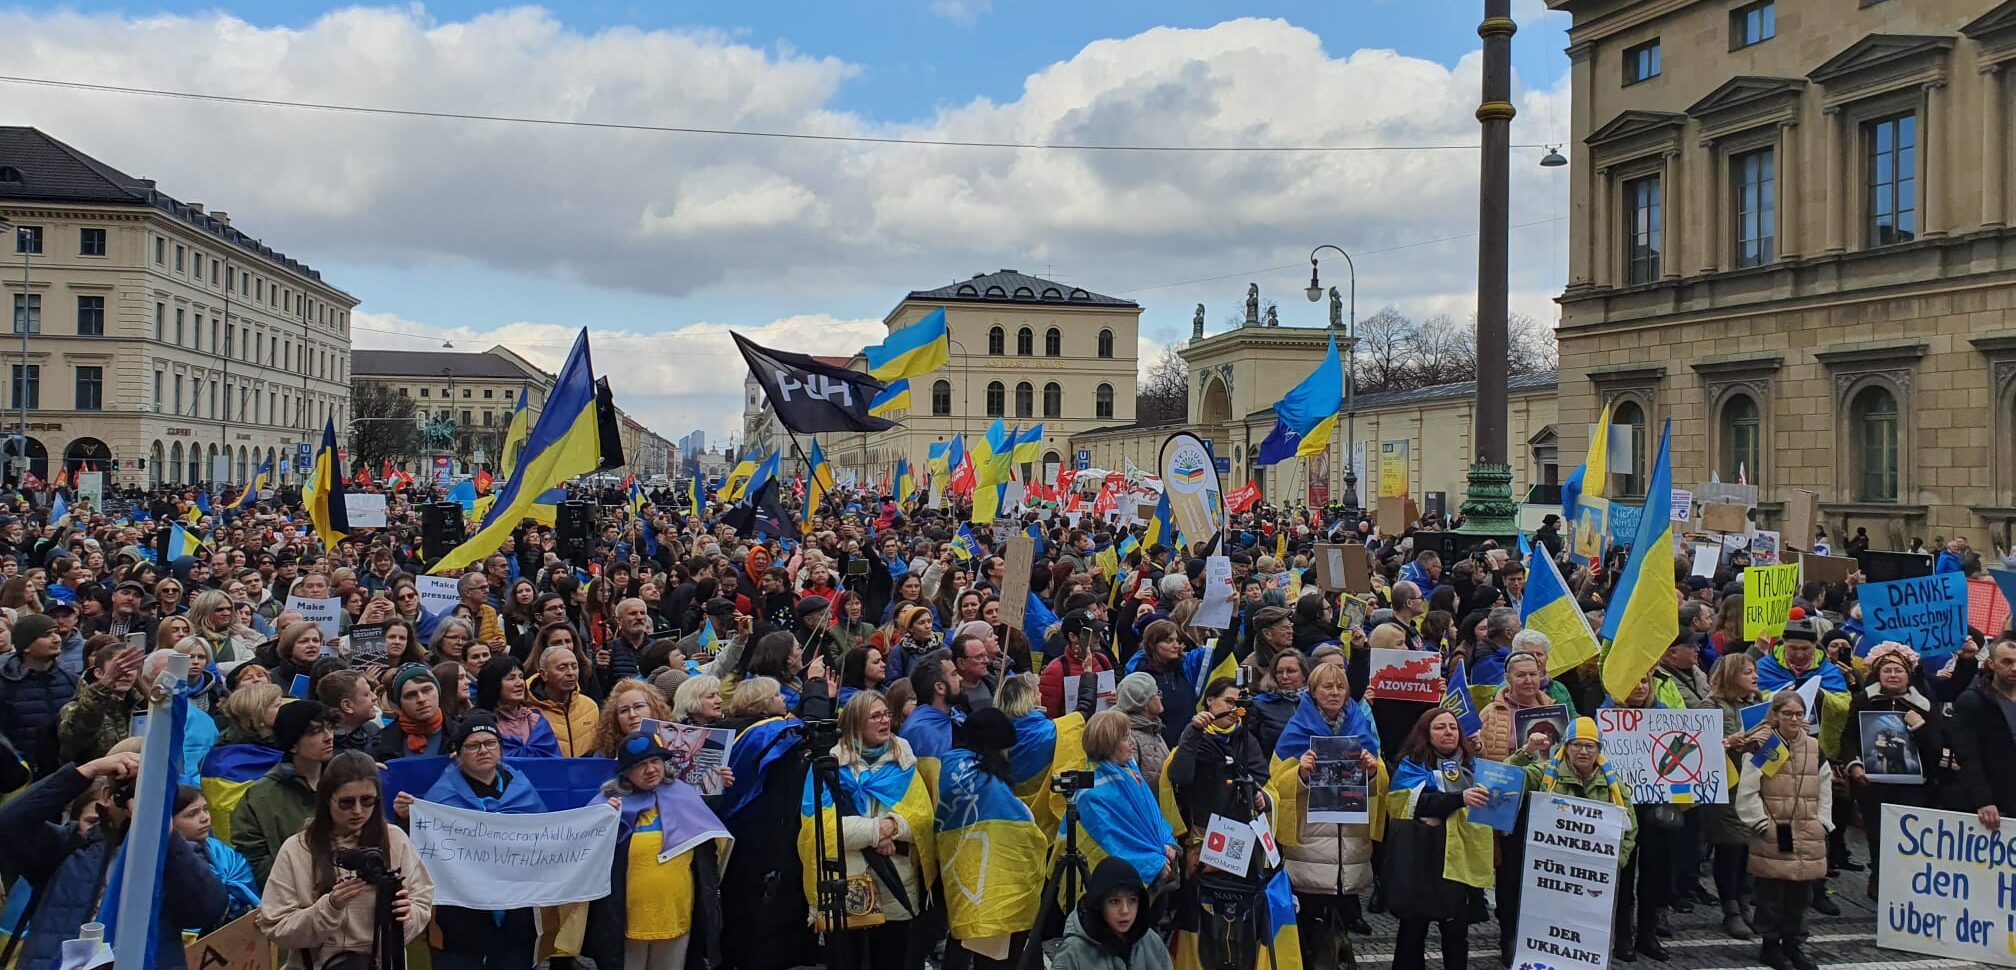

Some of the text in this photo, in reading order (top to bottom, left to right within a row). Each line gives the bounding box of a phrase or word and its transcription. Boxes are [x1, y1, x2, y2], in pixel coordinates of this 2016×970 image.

[1080, 451, 1088, 460] U
[431, 580, 456, 589] Make
[1753, 565, 1797, 598] TAURUS
[1888, 577, 1954, 607] DANKE
[296, 601, 326, 611] Make
[1920, 625, 1955, 652] ZSU
[1377, 680, 1433, 693] AZOVSTAL
[1600, 709, 1644, 733] STOP
[1602, 738, 1652, 756] RUSSIAN
[1699, 770, 1720, 785] US
[1693, 783, 1720, 804] SKY
[1571, 804, 1604, 820] WIR
[1555, 818, 1596, 835] SIND
[1533, 830, 1616, 857] DANKBAR
[1219, 859, 1242, 872] Munich
[1533, 858, 1610, 885] FÜR IHRE
[1536, 876, 1584, 896] HILFE
[1912, 862, 1970, 901] den
[1549, 925, 1582, 944] DER
[1956, 907, 1995, 947] der
[1526, 937, 1602, 966] UKRAINE
